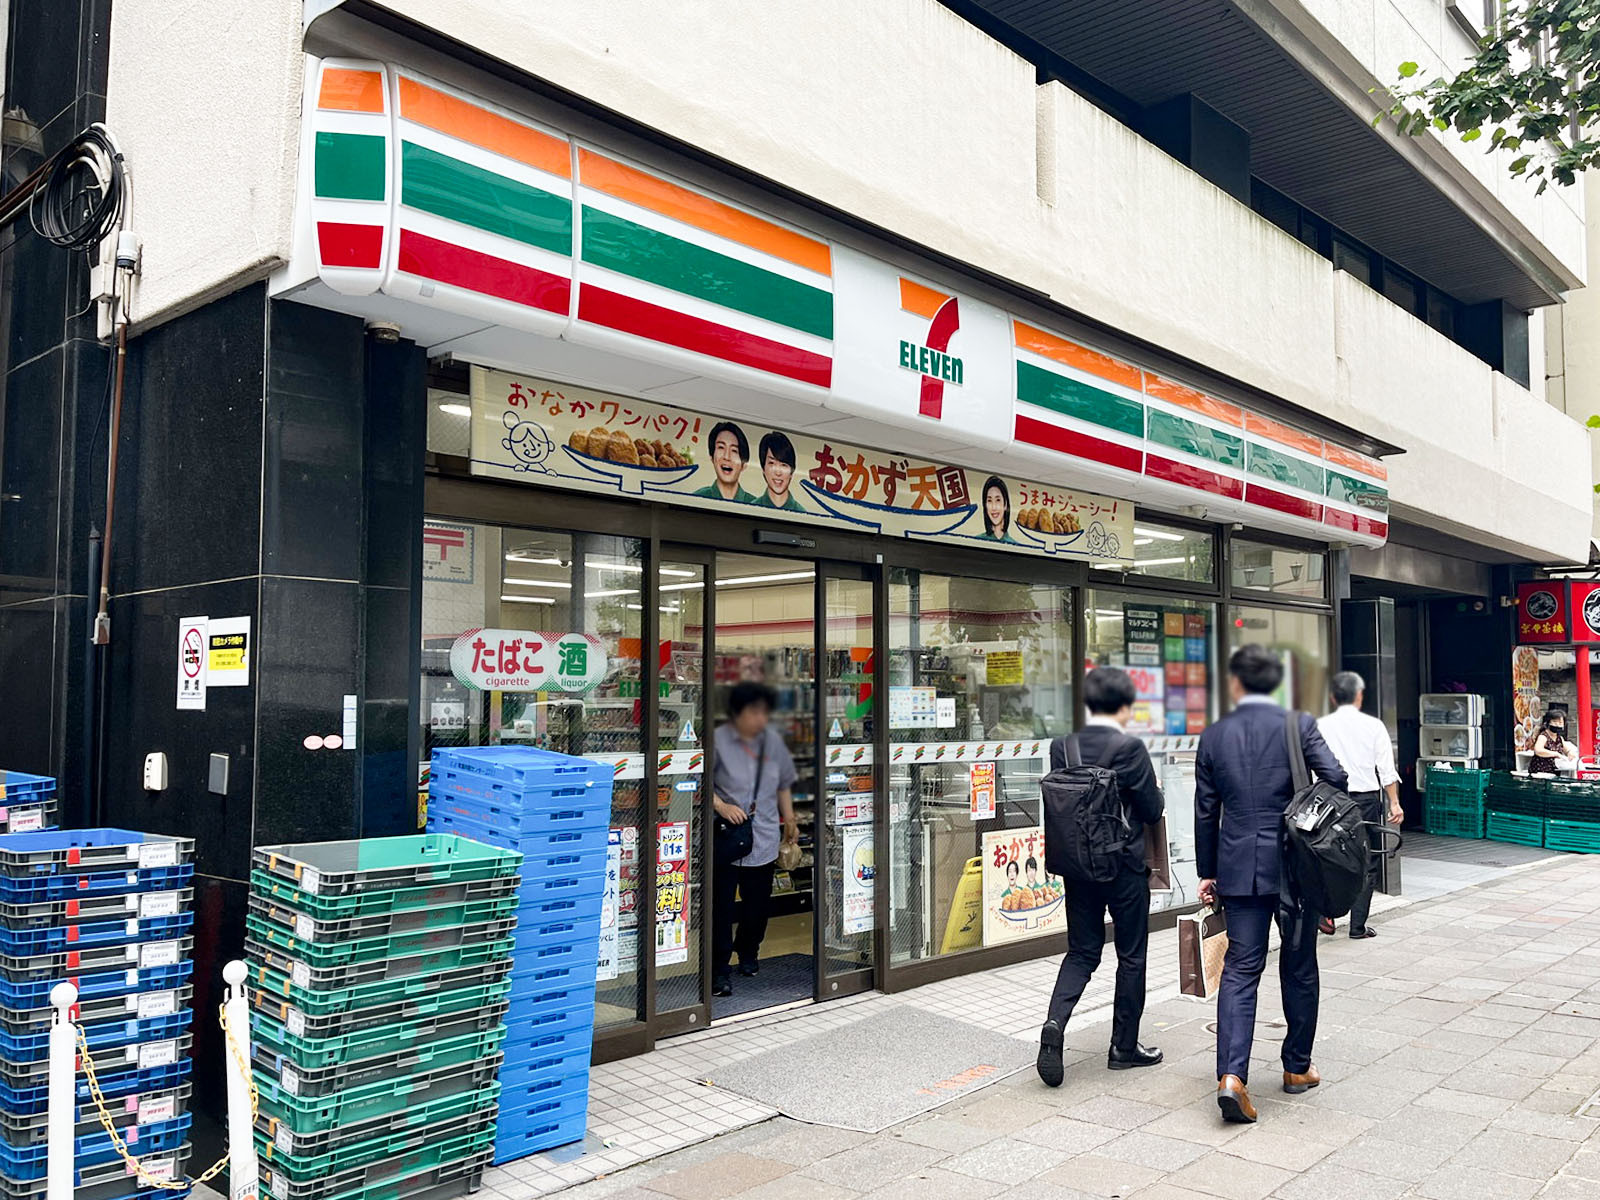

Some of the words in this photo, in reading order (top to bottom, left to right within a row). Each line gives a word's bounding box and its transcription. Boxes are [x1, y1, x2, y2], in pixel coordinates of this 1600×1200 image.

[507, 381, 702, 445] おなかワンパク!
[809, 443, 972, 511] おかず天国
[1018, 483, 1118, 522] うまみジューシー!
[471, 637, 545, 675] たばこ
[558, 641, 588, 676] 酒
[485, 677, 530, 688] cigarette
[560, 678, 588, 688] liquor
